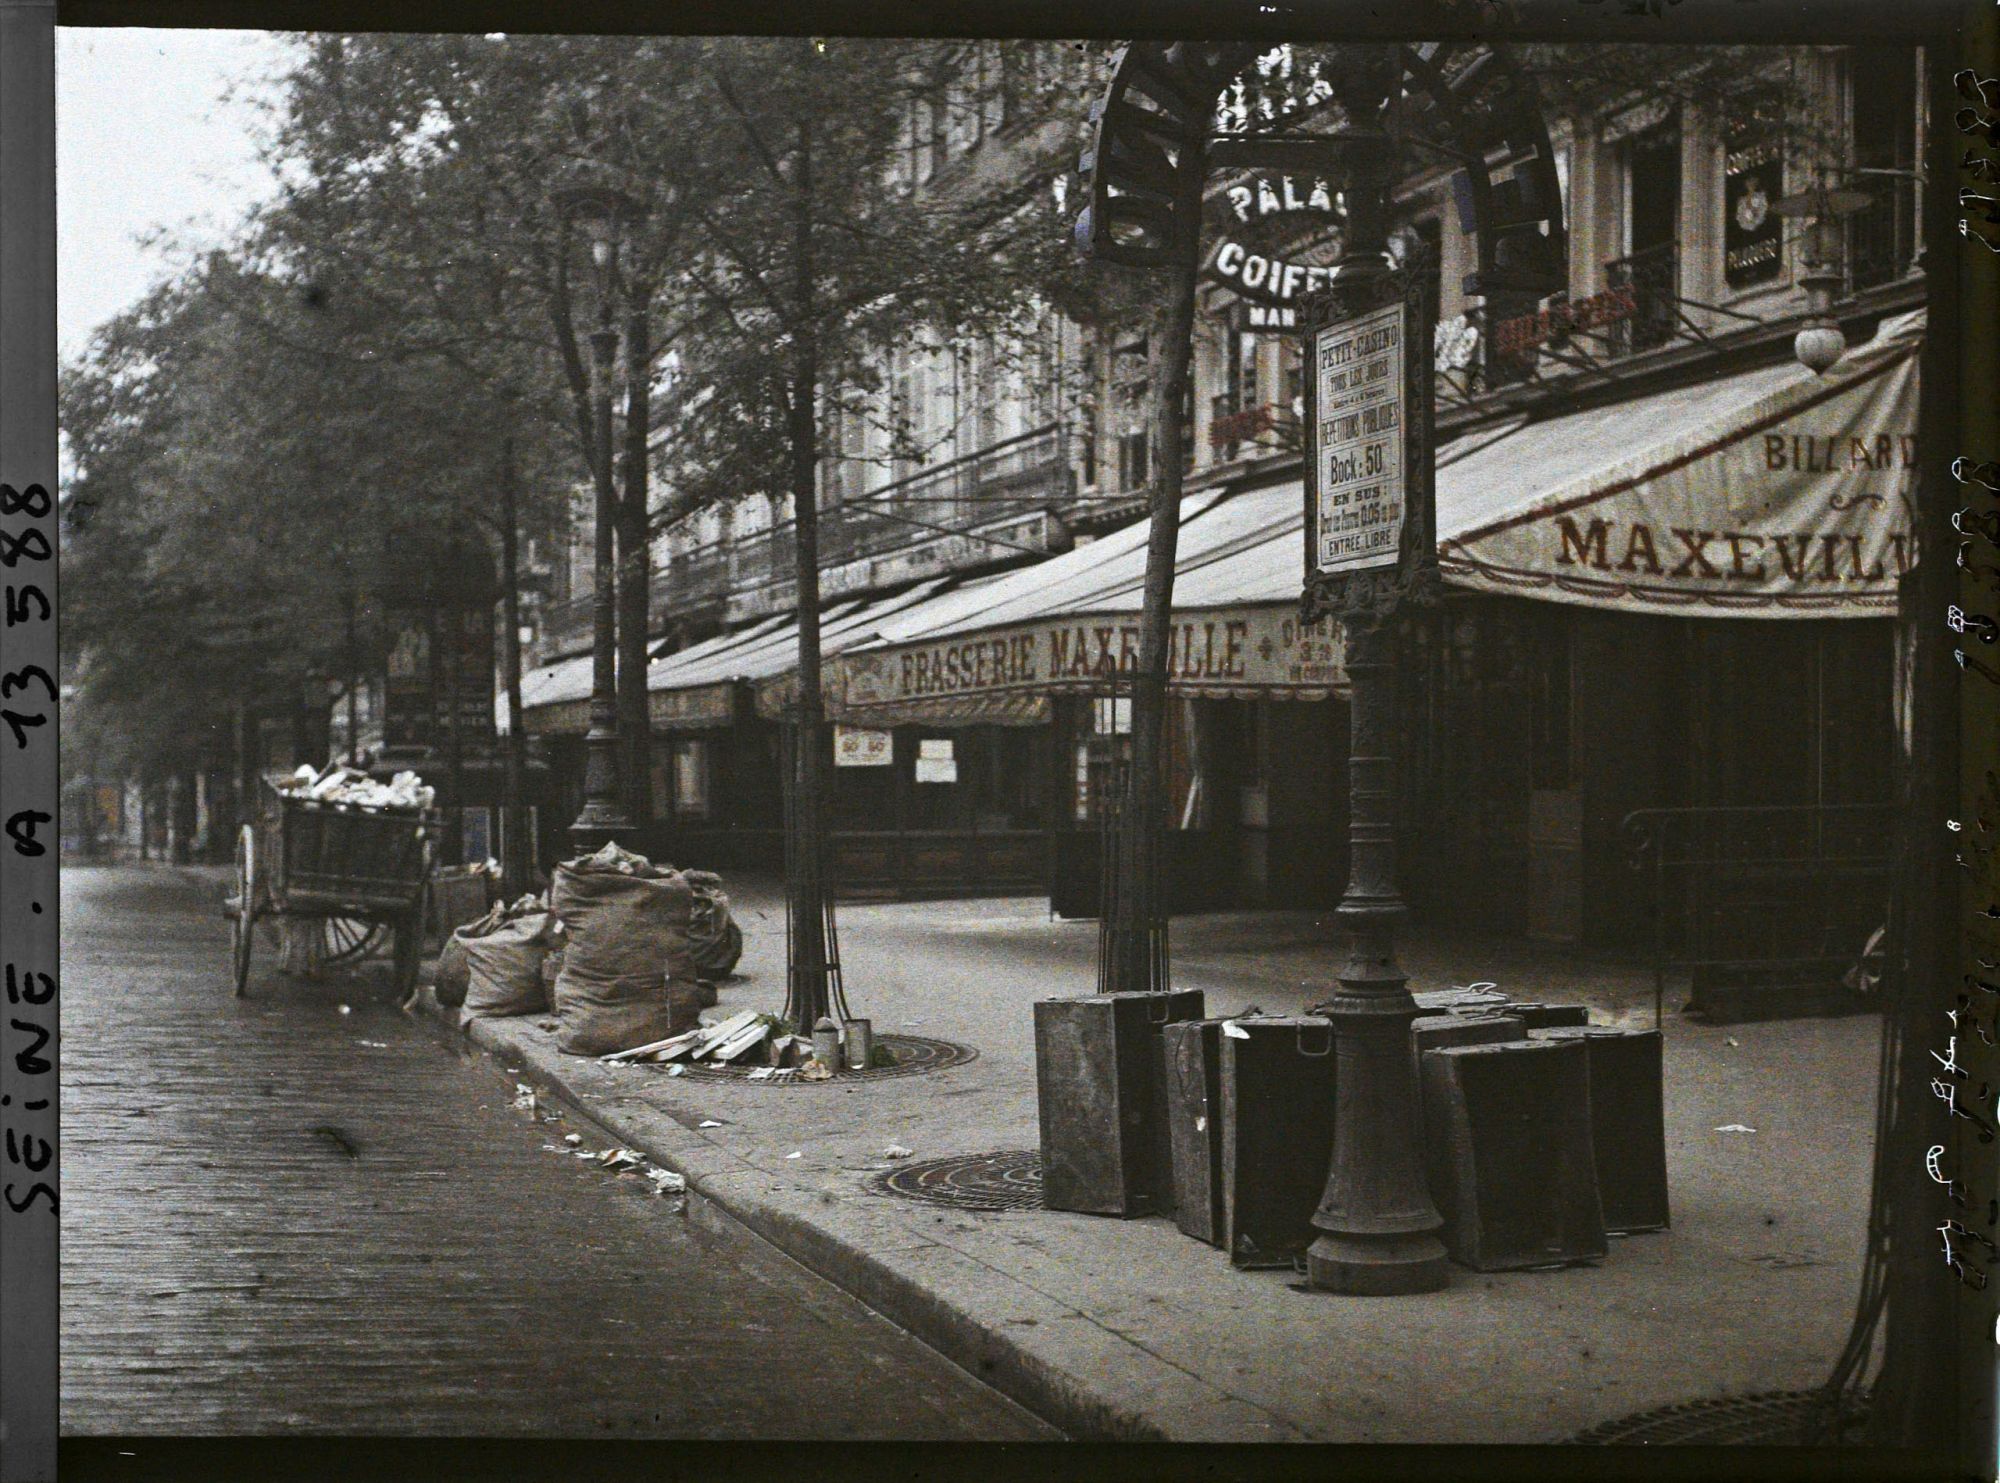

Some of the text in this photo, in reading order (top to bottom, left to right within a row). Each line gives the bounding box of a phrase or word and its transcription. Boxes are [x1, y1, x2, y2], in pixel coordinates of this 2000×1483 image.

[1322, 325, 1397, 369] PETIT-CASINO
[1366, 443, 1382, 476] 50
[1334, 492, 1349, 506] EN
[1365, 529, 1391, 550] LIBRE
[1049, 619, 1247, 680] MAXEILLE
